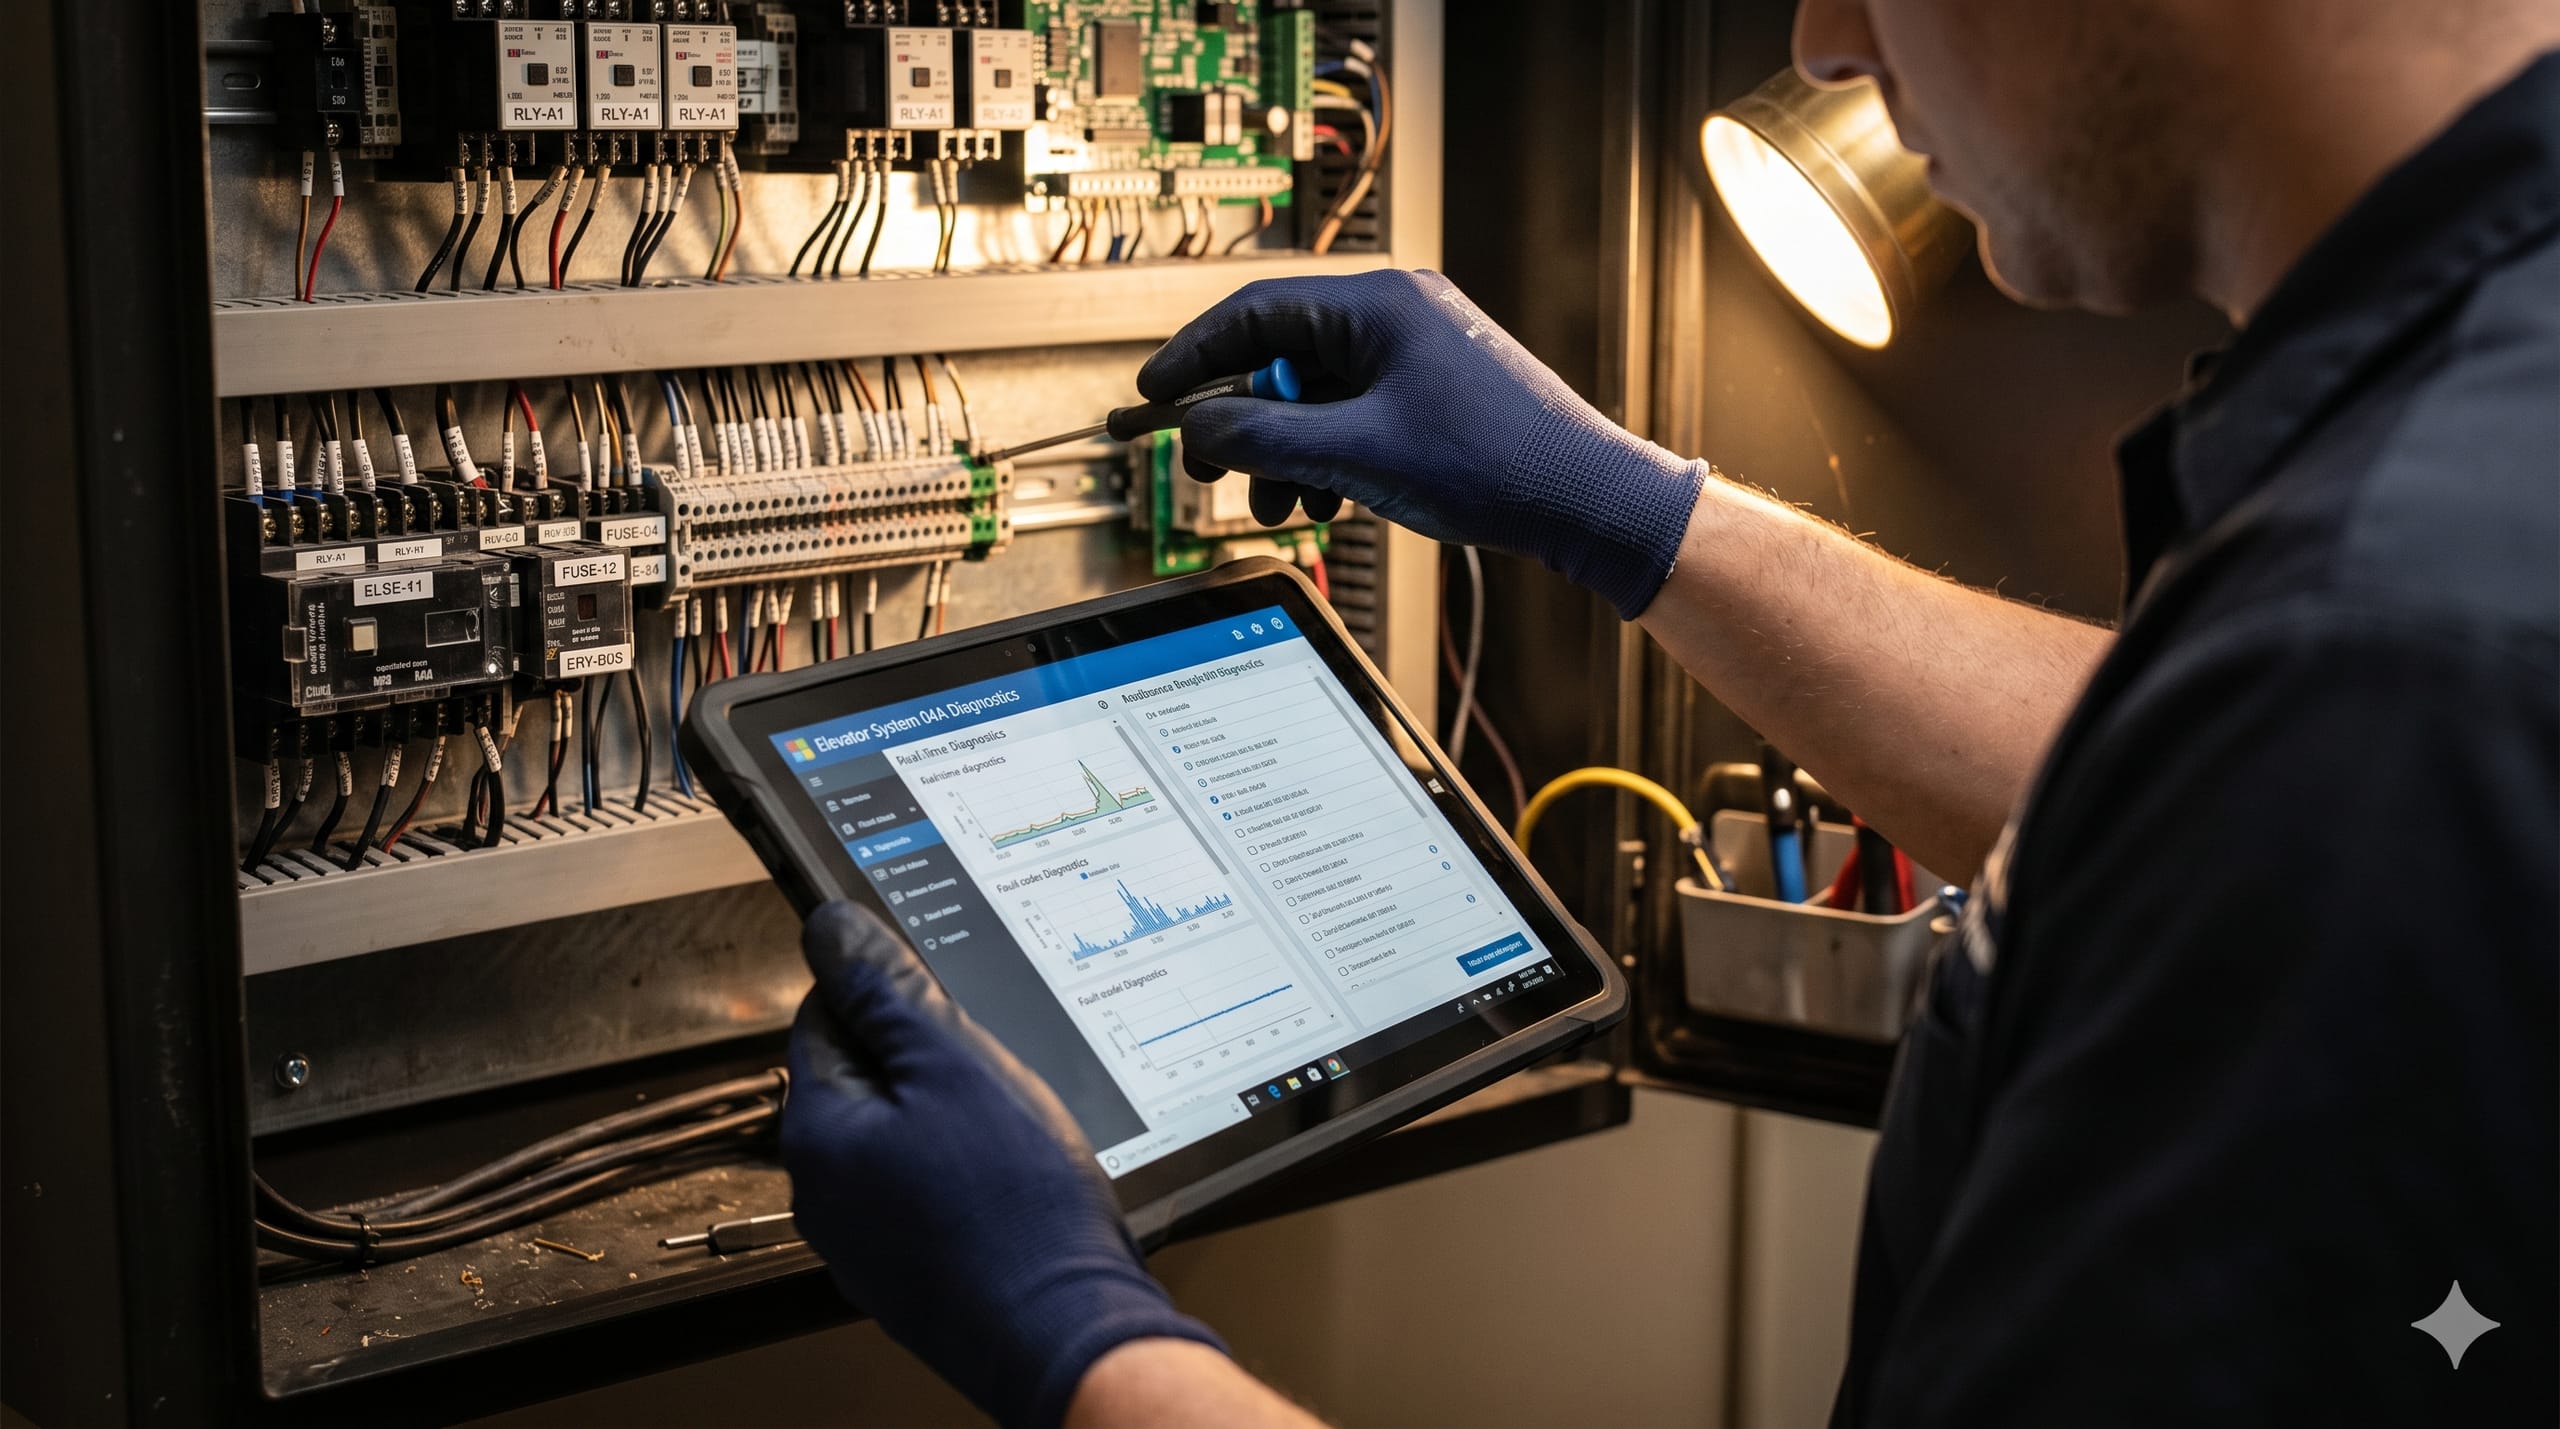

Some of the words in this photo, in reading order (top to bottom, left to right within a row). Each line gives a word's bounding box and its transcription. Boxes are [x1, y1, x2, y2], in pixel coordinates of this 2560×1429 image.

[514, 107, 563, 121] RLY-A1
[601, 107, 649, 121] RLY-A1
[679, 107, 726, 121] RLY-A1
[900, 107, 944, 120] RLY-A1
[606, 526, 659, 541] FUSE-04
[316, 553, 346, 564] RLY-A1
[562, 562, 617, 579] FUSE-12
[814, 727, 871, 753] Elevator
[870, 715, 921, 741] System
[919, 707, 950, 725] 04A
[949, 688, 1021, 718] Diagnostics
